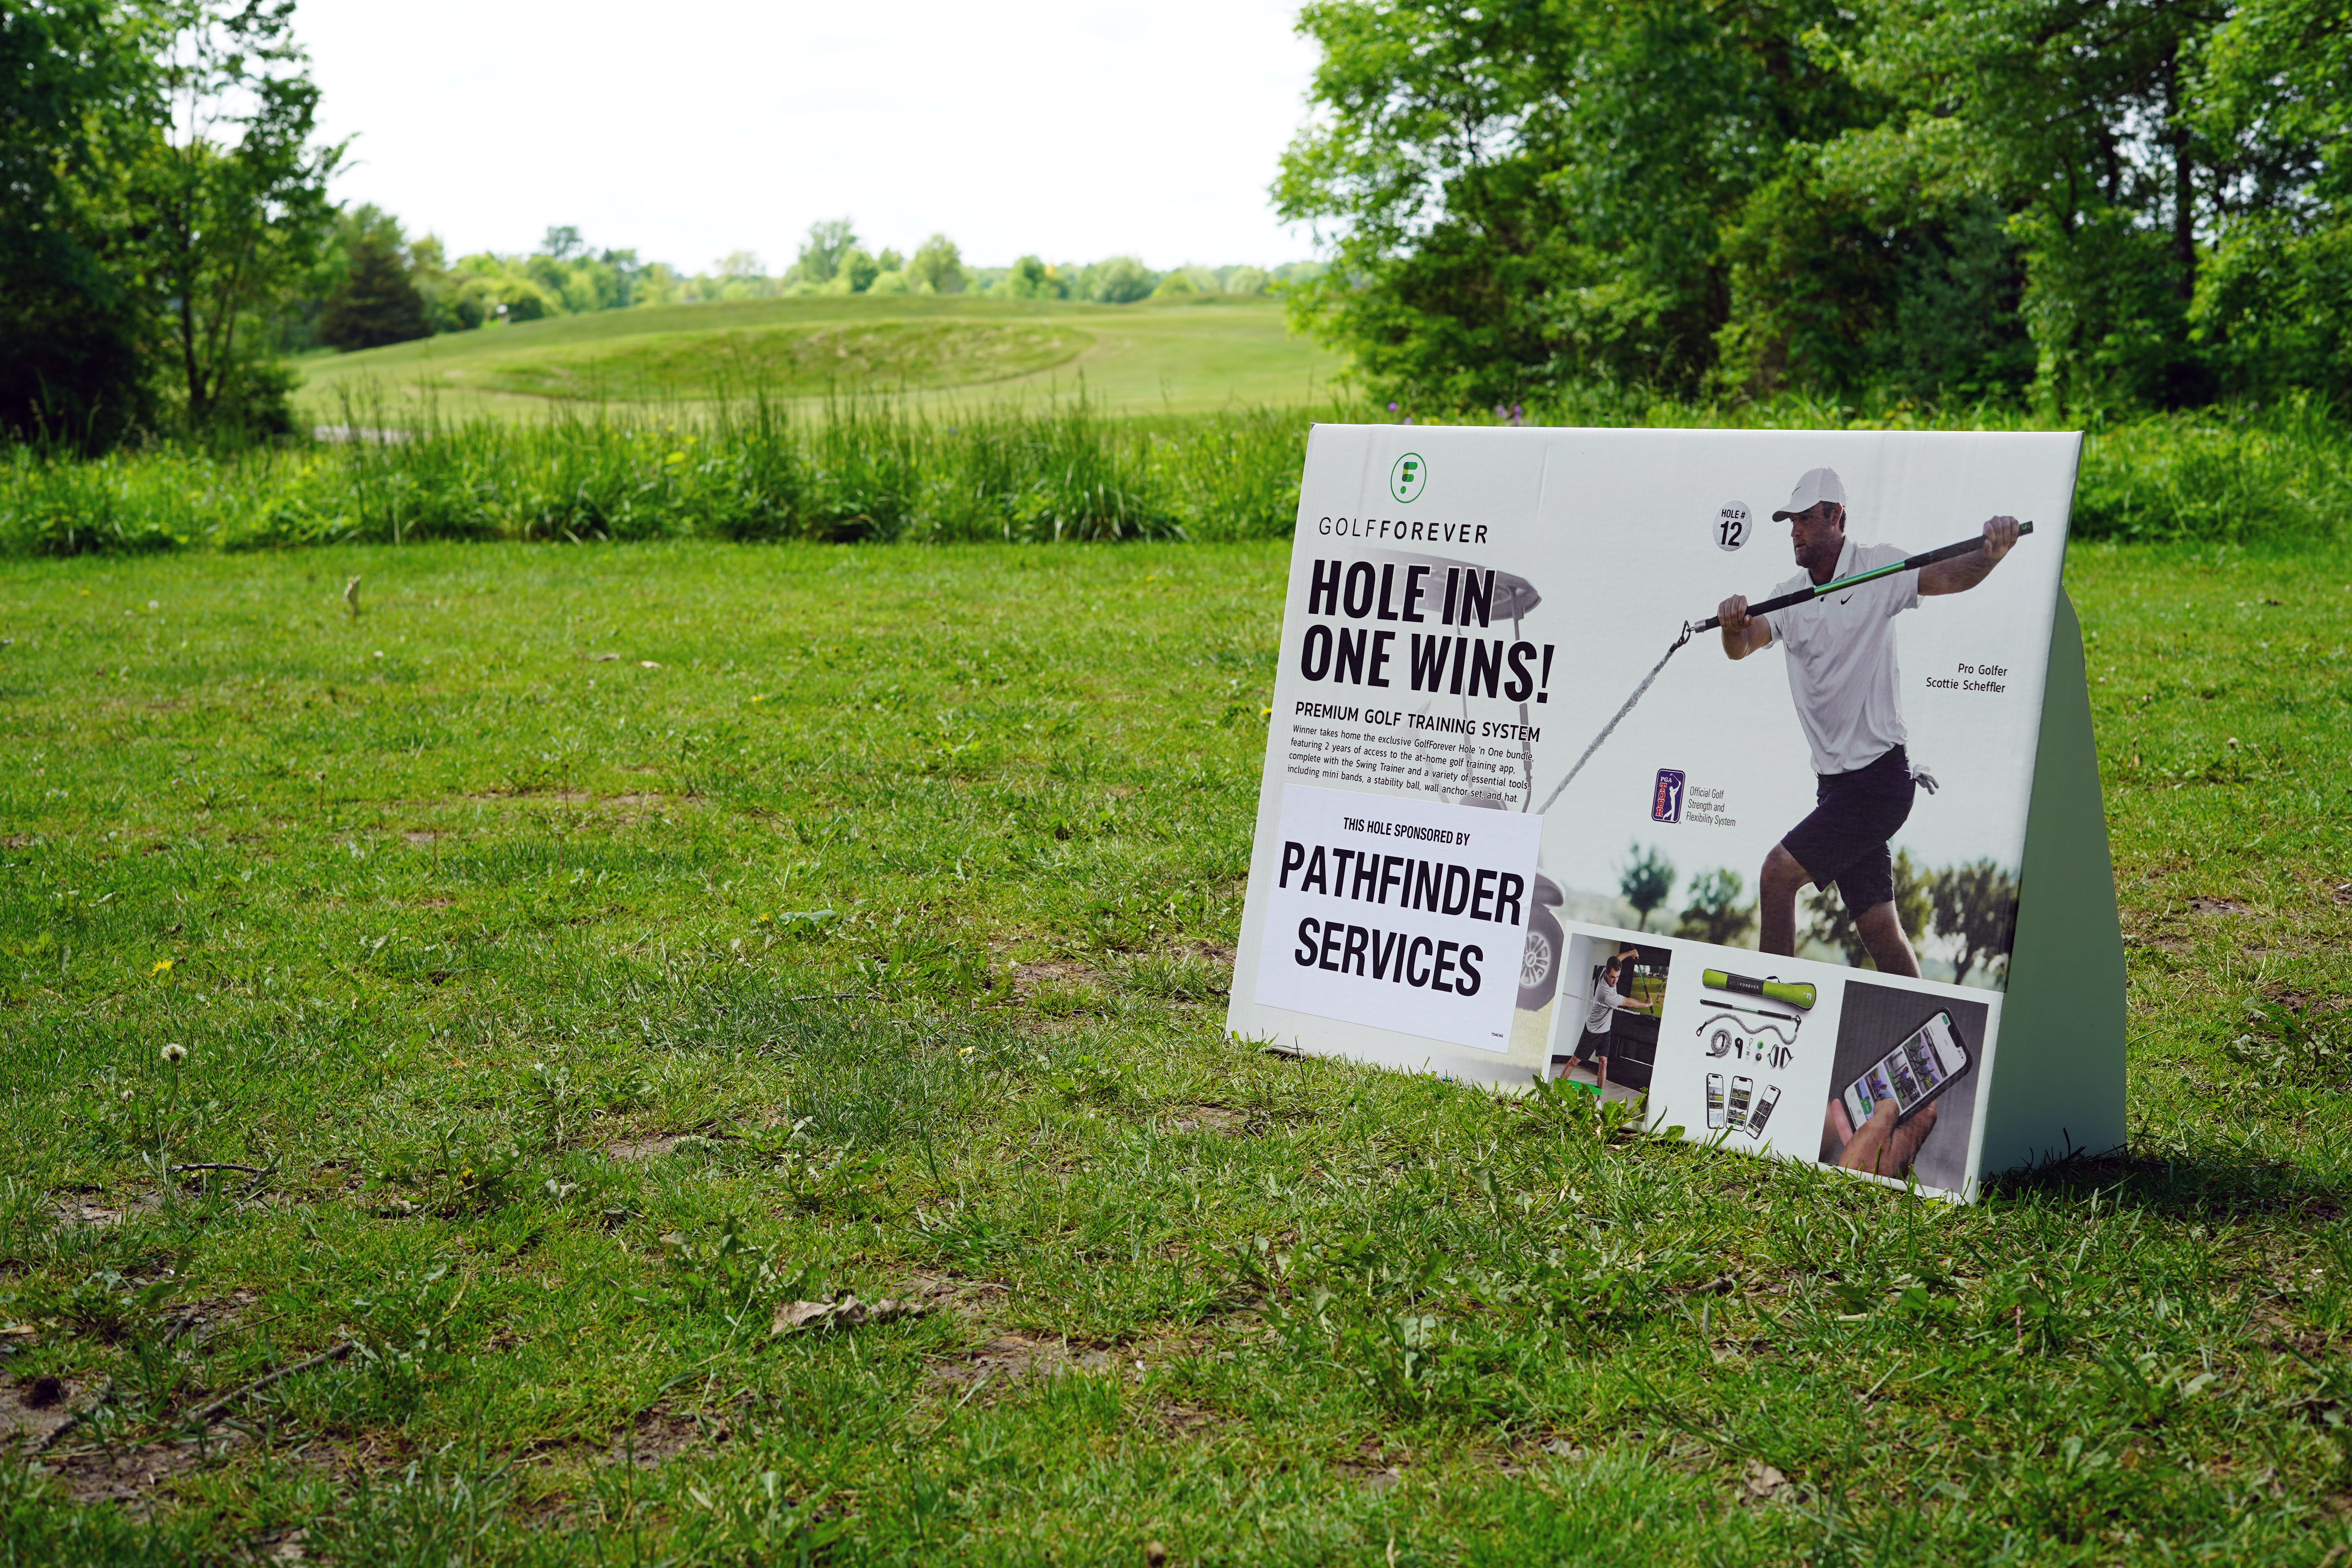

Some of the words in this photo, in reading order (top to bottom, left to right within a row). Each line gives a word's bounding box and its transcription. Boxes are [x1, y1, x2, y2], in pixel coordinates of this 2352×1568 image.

[1319, 517, 1487, 544] GOLFFOREVER
[1721, 509, 1740, 519] HOLE
[1740, 511, 1746, 519] #
[1720, 521, 1742, 546] 12
[1308, 559, 1430, 623] HOLE
[1442, 568, 1495, 628] IN
[1301, 624, 1396, 688] ONE
[1411, 633, 1555, 704] WINS!
[1958, 663, 1974, 674] Pro
[1978, 664, 2008, 676] Golfer
[1926, 677, 1958, 689] Scottie
[1963, 680, 2005, 693] Scheffler
[1296, 701, 1359, 722] PREMIUM
[1365, 709, 1402, 726] GOLF
[1408, 713, 1476, 735] TRAINING
[1482, 721, 1540, 742] SYSTEM
[1291, 737, 1322, 751] featuring
[1325, 742, 1329, 750] 2
[1332, 745, 1351, 753] years
[1354, 746, 1362, 754] of
[1364, 748, 1387, 757] access
[1390, 750, 1397, 759] to
[1401, 751, 1412, 760] the
[1415, 754, 1446, 764] at-home
[1449, 758, 1464, 768] golf
[1466, 760, 1496, 773] training
[1499, 765, 1515, 775] app,
[1293, 724, 1317, 735] Winner
[1320, 728, 1338, 737] takes
[1341, 730, 1361, 740] home
[1364, 733, 1375, 742] the
[1378, 735, 1411, 746] exclusive
[1414, 739, 1456, 751] GolfForever
[1459, 744, 1475, 754] Hole
[1488, 748, 1503, 757] One
[1506, 749, 1534, 762] bundle,
[1288, 765, 1320, 778] including
[1341, 771, 1363, 783] bands,
[1374, 777, 1404, 789] stability
[1406, 780, 1421, 791] ball,
[1425, 783, 1439, 792] wall
[1442, 786, 1468, 796] anchor
[1471, 790, 1483, 799] set,
[1487, 791, 1502, 800] and
[1504, 792, 1518, 802] hat.
[1289, 753, 1321, 763] complete
[1324, 757, 1339, 765] with
[1342, 758, 1353, 767] the
[1356, 759, 1377, 772] Swing
[1380, 762, 1405, 773] Trainer
[1408, 767, 1422, 775] and
[1432, 771, 1458, 782] variety
[1461, 773, 1469, 781] of
[1472, 776, 1506, 786] essential
[1509, 778, 1531, 791] tools,
[1655, 782, 1667, 817] TOUR
[1688, 799, 1712, 812] Strength
[1713, 803, 1725, 812] and
[1690, 786, 1710, 798] Official
[1711, 789, 1724, 799] Golf
[1344, 817, 1365, 832] THIS
[1367, 820, 1392, 835] HOLE
[1394, 824, 1453, 844] SPONSORED
[1456, 832, 1470, 846] BY
[1686, 811, 1713, 826] Flexibility
[1714, 815, 1736, 827] System
[1279, 841, 1524, 926] PATHFINDER
[1295, 917, 1483, 996] SERVICES
